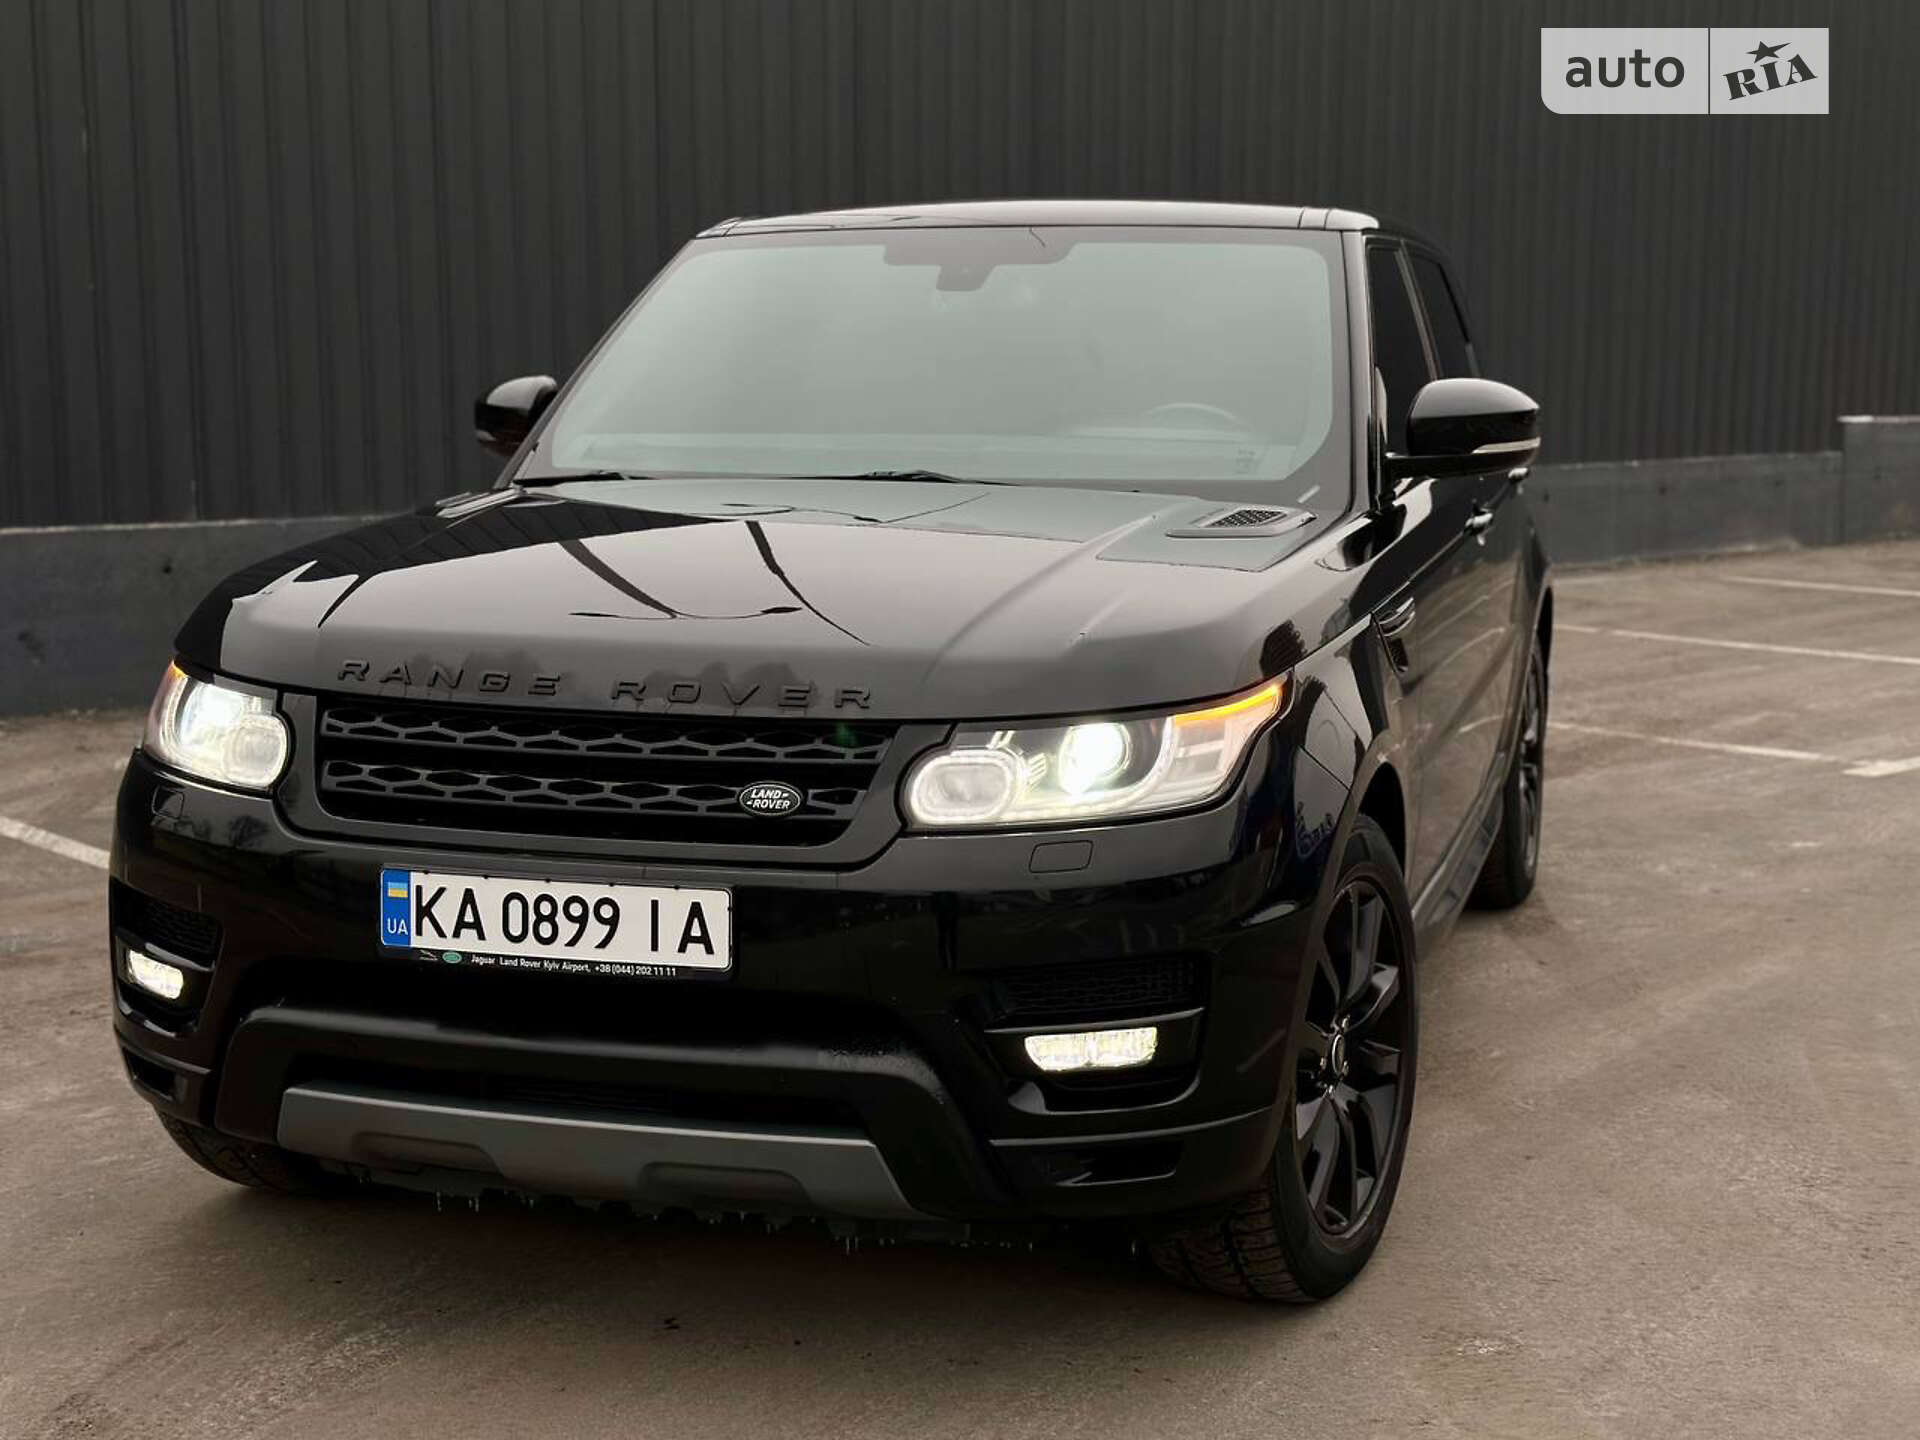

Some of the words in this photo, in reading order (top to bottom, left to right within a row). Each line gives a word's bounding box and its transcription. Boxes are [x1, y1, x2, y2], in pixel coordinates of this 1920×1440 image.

[337, 659, 561, 697] RANGE
[611, 680, 871, 709] ROVER
[387, 917, 409, 936] UA
[415, 884, 486, 941] KA
[501, 891, 620, 949] 0899
[471, 954, 496, 966] Jaguar
[500, 957, 518, 967] Land
[520, 958, 541, 969] Rover
[543, 959, 560, 971] Kyiv
